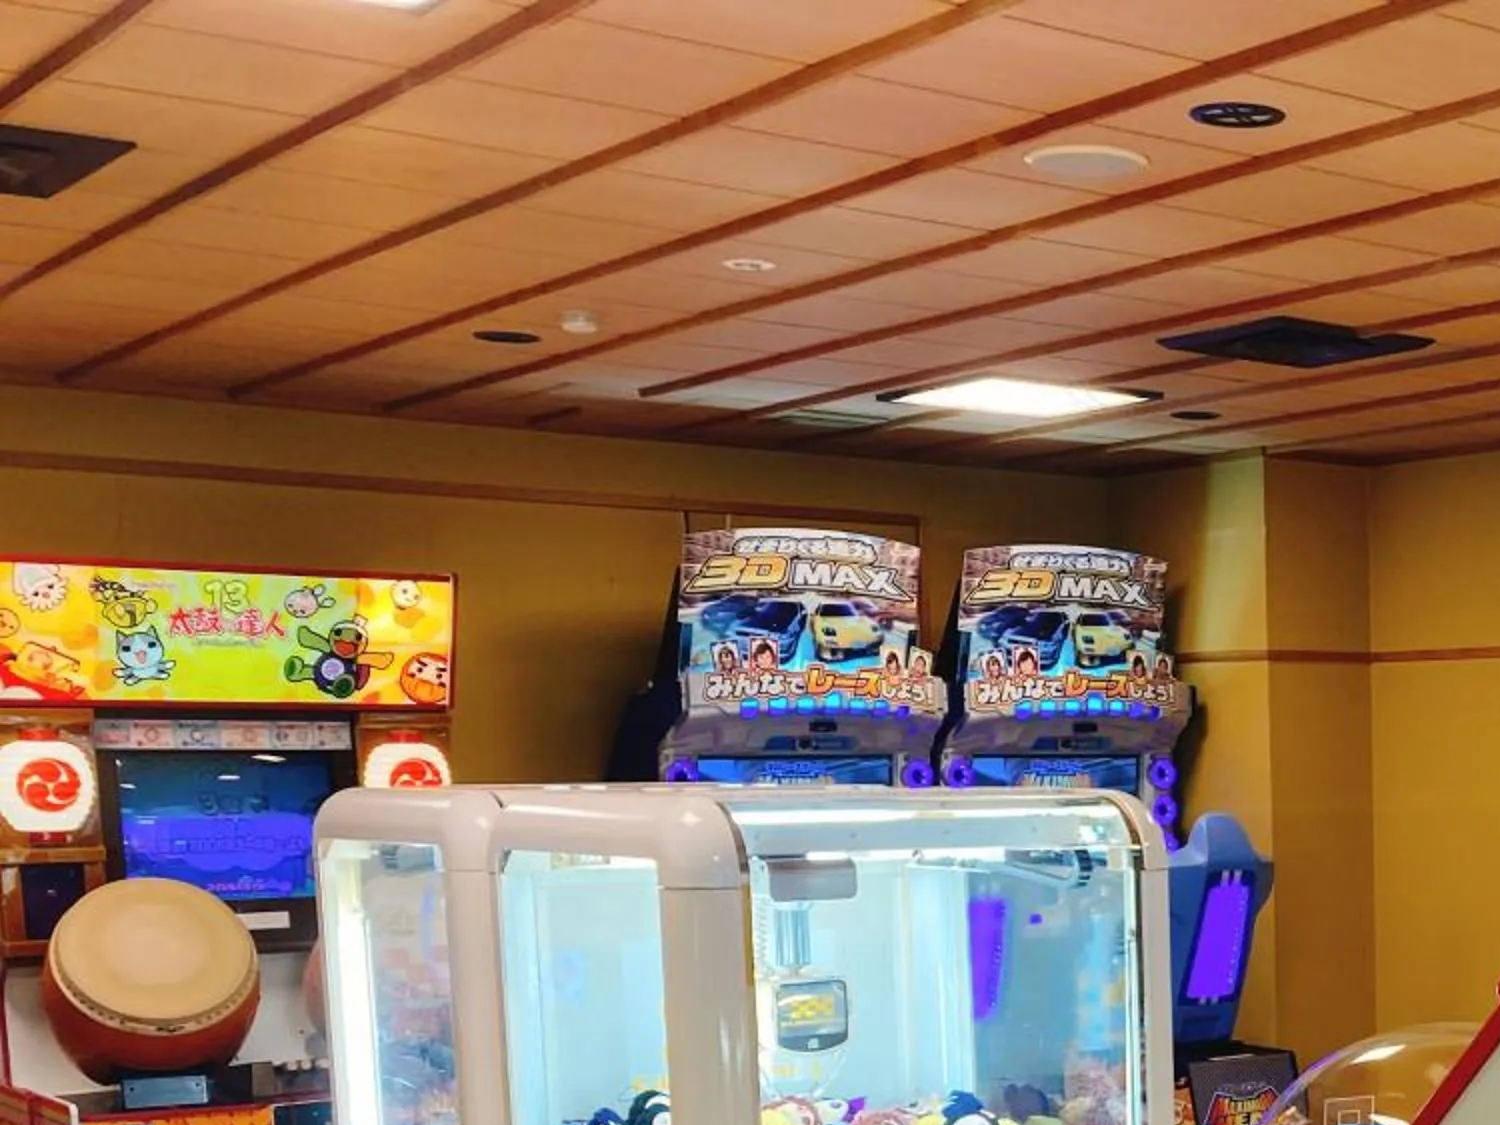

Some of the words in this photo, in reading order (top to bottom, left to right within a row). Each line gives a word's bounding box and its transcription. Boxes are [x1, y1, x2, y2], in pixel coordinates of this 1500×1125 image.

[687, 554, 788, 590] 3D
[791, 559, 901, 595] MAX
[967, 570, 1055, 603] 3D
[1058, 575, 1149, 606] MAX
[205, 579, 250, 615] 13
